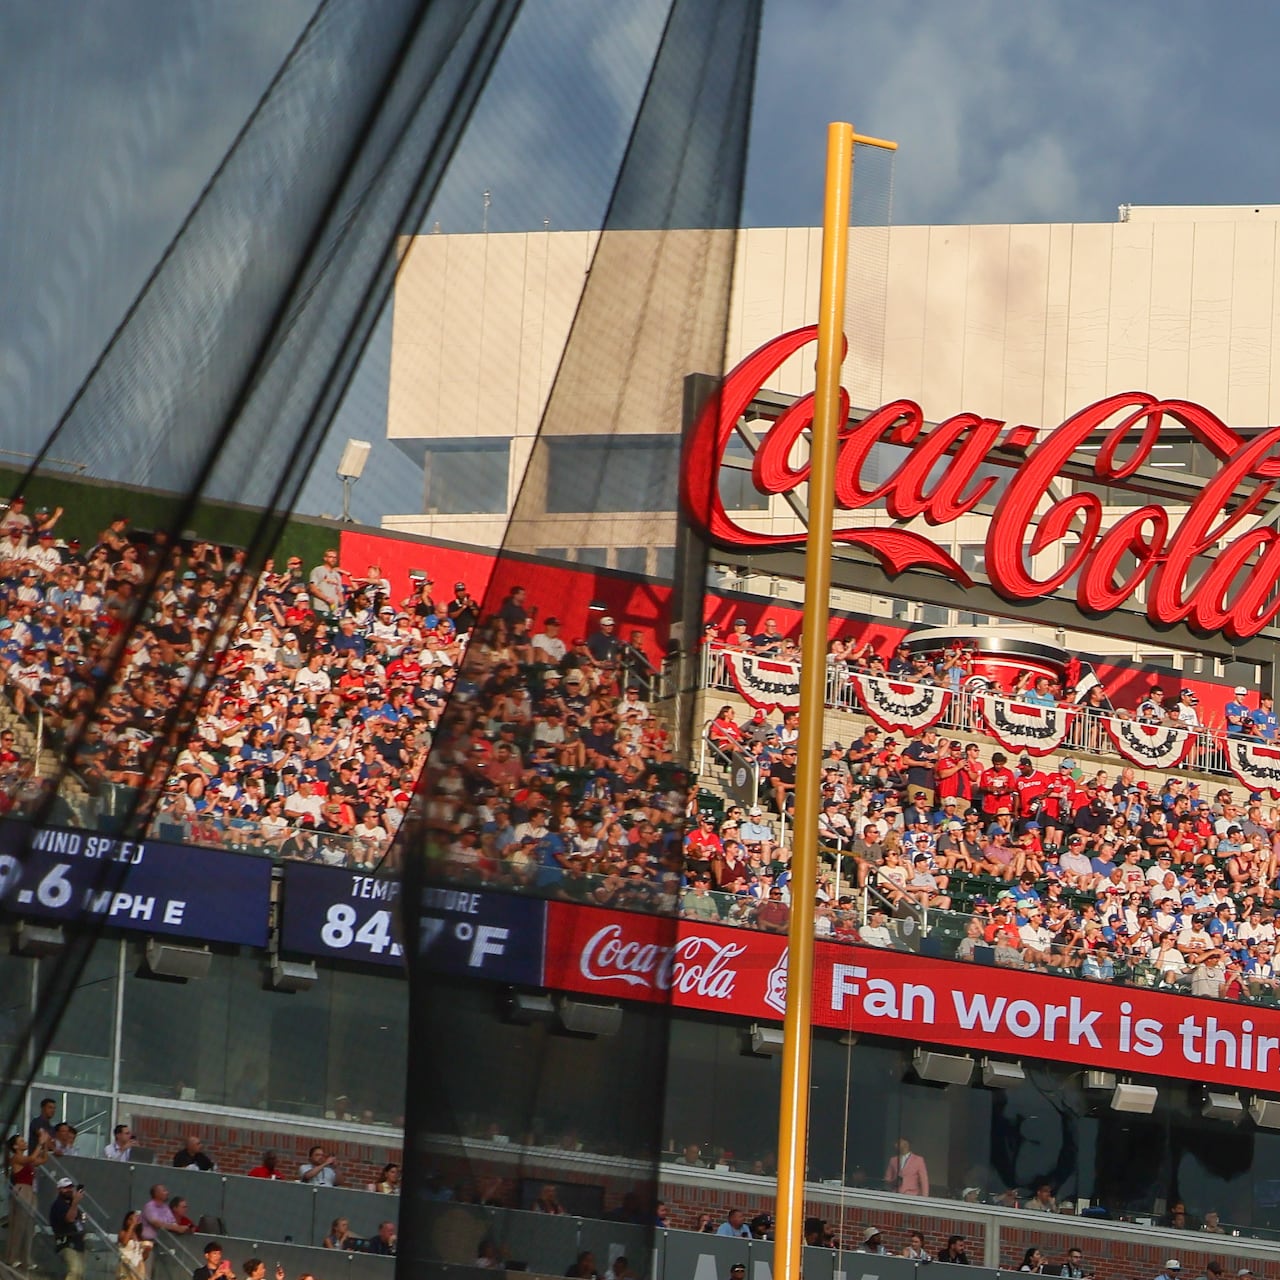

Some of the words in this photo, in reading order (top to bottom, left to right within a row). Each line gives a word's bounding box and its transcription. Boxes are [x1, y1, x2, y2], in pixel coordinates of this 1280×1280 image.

[163, 899, 186, 925] E
[831, 963, 935, 1024] Fan
[951, 990, 1103, 1049] work
[1119, 1002, 1164, 1057] is
